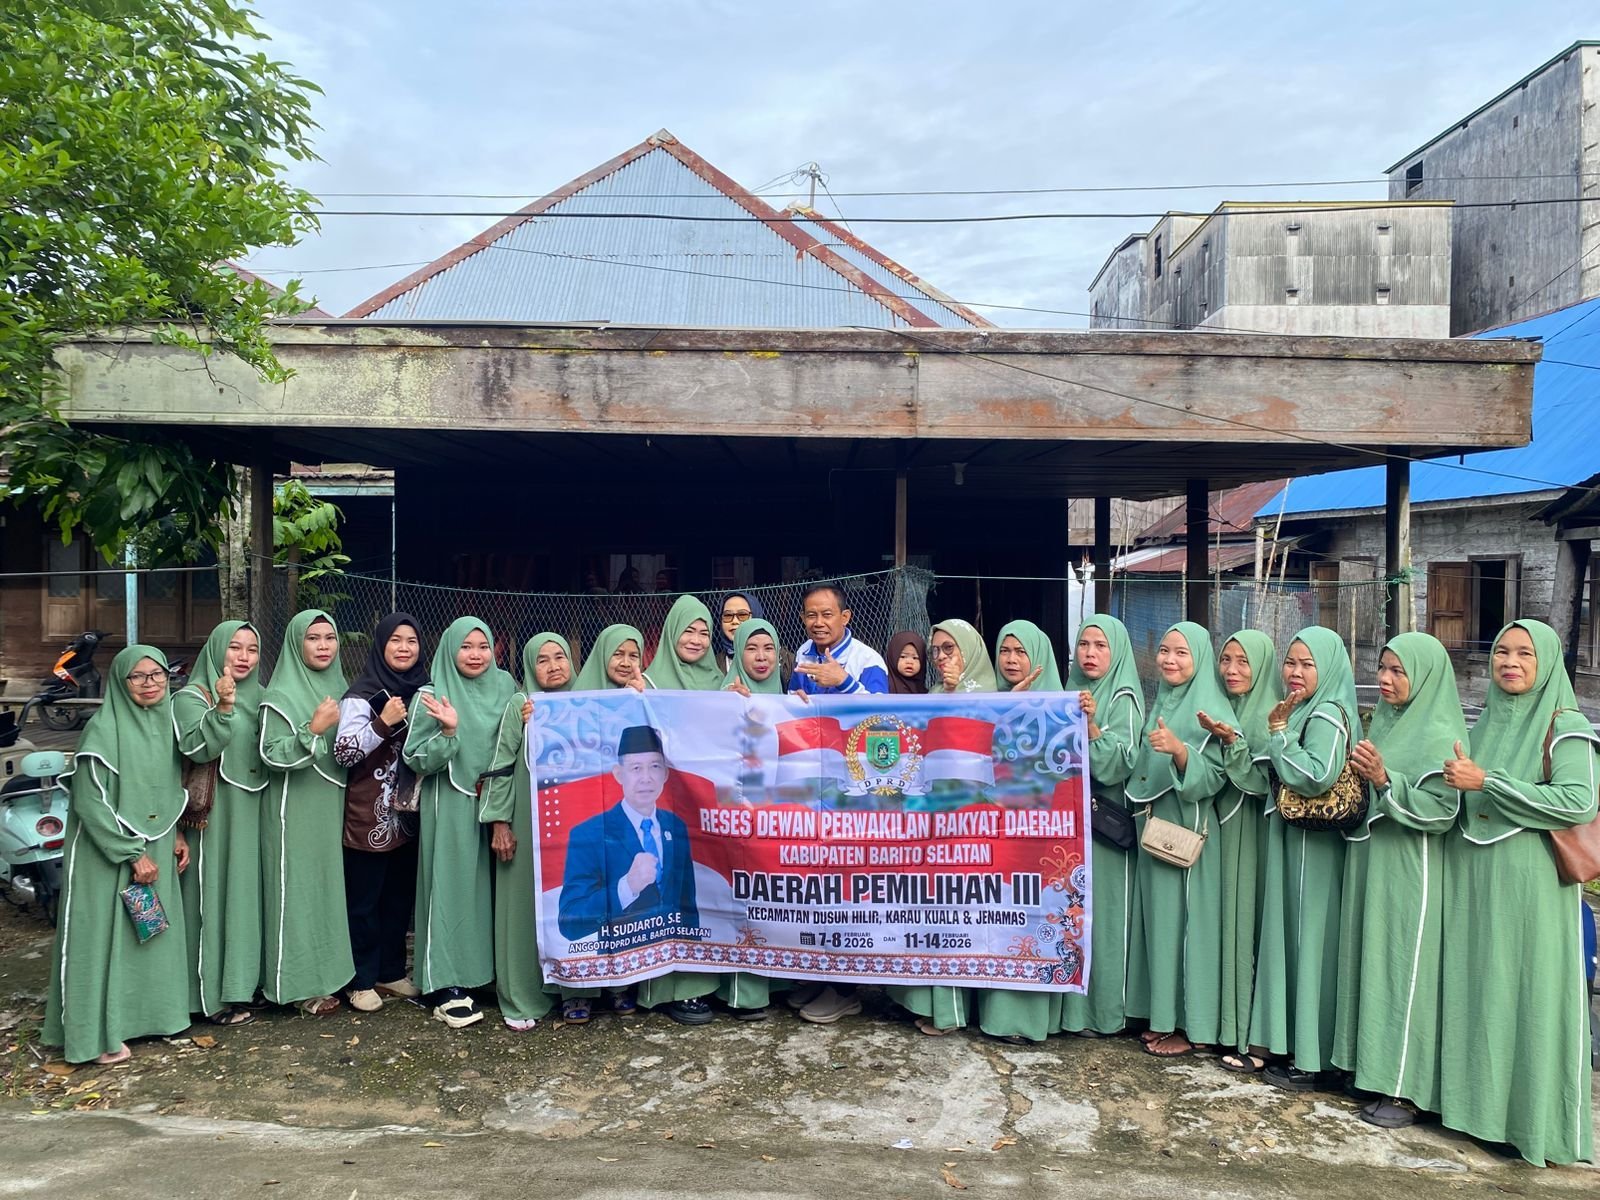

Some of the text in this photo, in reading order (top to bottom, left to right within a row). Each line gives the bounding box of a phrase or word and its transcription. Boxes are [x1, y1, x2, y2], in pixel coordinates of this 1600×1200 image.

[864, 778, 906, 788] DPRD
[699, 808, 1075, 839] RESES DEWAN PERWAKILAN RAKYAT DAERAH
[779, 843, 991, 865] KABUPATEN BARITO SELATAN
[733, 871, 1040, 906] DAERAH PEMILIHAN III
[613, 916, 665, 937] SUDIARTO,
[667, 912, 681, 924] S.E
[747, 906, 810, 923] KECAMATAN
[813, 911, 849, 924] DUSUN
[886, 910, 921, 924] KARAU
[925, 910, 959, 925] KUALA
[963, 911, 972, 925] &
[976, 910, 1026, 926] JENAMAS
[569, 926, 711, 953] ANGGOTA DPRD KAB. BARITO SELATAN
[819, 932, 842, 948] 7-8
[844, 938, 874, 948] 2026
[904, 932, 941, 949] 11-14
[942, 938, 972, 948] 2026
